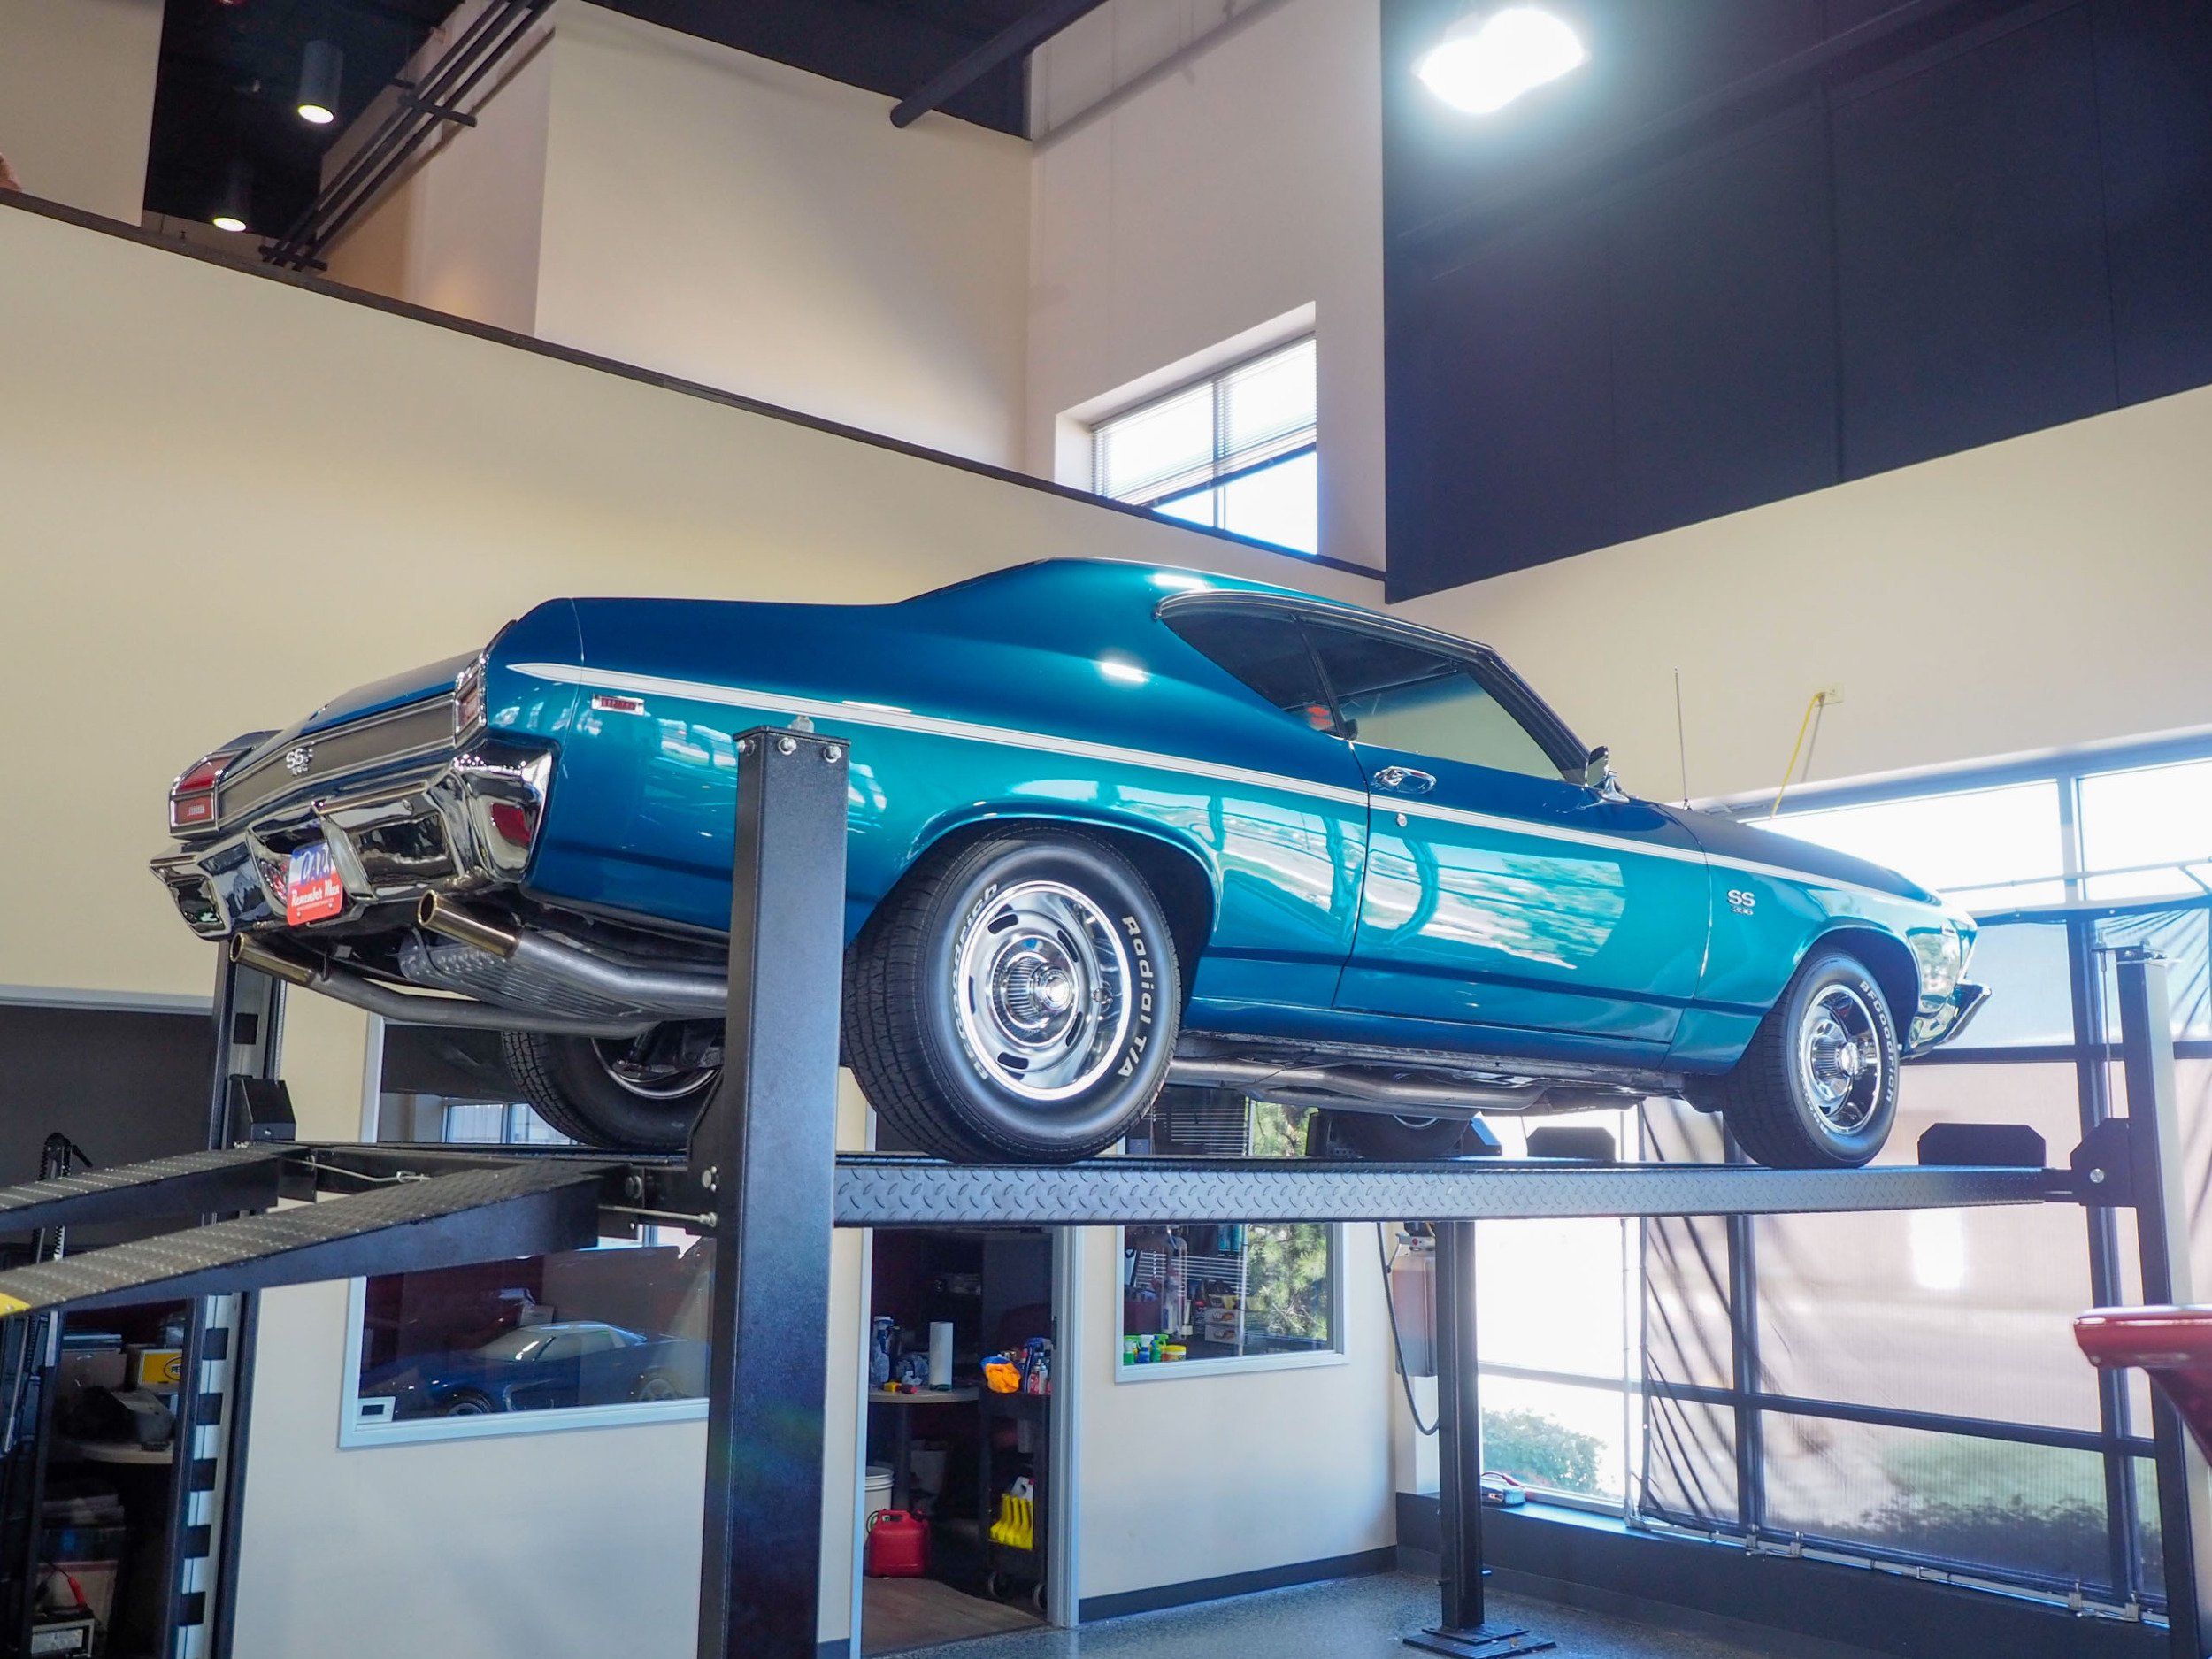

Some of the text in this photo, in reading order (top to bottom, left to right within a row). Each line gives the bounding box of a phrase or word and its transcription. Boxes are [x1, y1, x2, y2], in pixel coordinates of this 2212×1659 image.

[286, 748, 304, 769] SS
[1727, 889, 1756, 908] SS
[1118, 915, 1154, 1078] Radial T/A
[1859, 980, 1895, 1102] BFGoodrich
